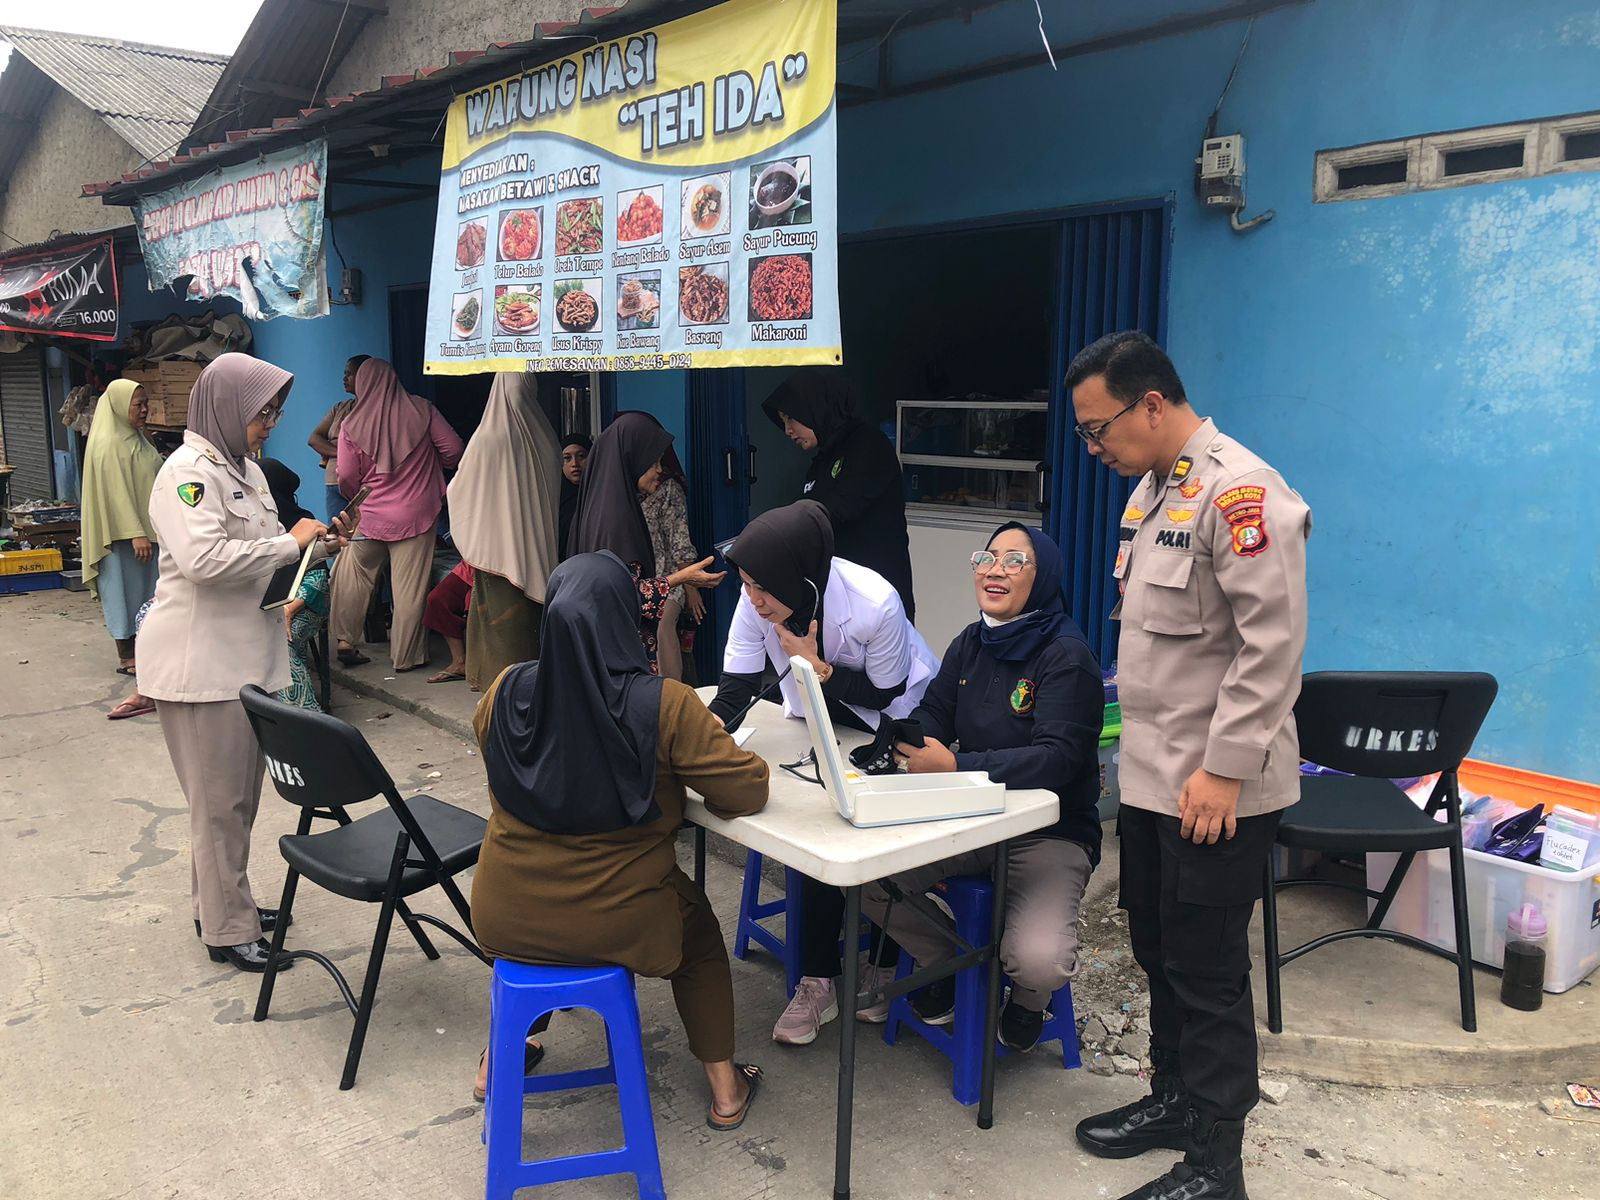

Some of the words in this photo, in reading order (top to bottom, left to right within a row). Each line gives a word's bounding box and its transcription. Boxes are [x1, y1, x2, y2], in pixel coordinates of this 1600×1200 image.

[466, 60, 577, 137] WARUNG
[581, 33, 657, 101] NASI
[498, 176, 546, 201] BETAWI
[557, 164, 600, 191] SNACK
[212, 183, 234, 220] AIR
[678, 243, 705, 262] Sayur
[706, 239, 731, 255] Asem
[743, 233, 771, 254] Sayur
[773, 229, 817, 250] Pucung
[574, 256, 604, 275] Tempe
[640, 246, 670, 264] Balado
[516, 263, 544, 279] Balado
[685, 328, 723, 349] Basreng
[752, 324, 808, 341] Makaroni
[440, 343, 465, 358] Tumis
[490, 338, 512, 357] Ayam
[514, 338, 543, 356] Goreng
[572, 335, 604, 355] Krispy
[1155, 528, 1191, 549] POLRI
[1344, 725, 1439, 752] URKES
